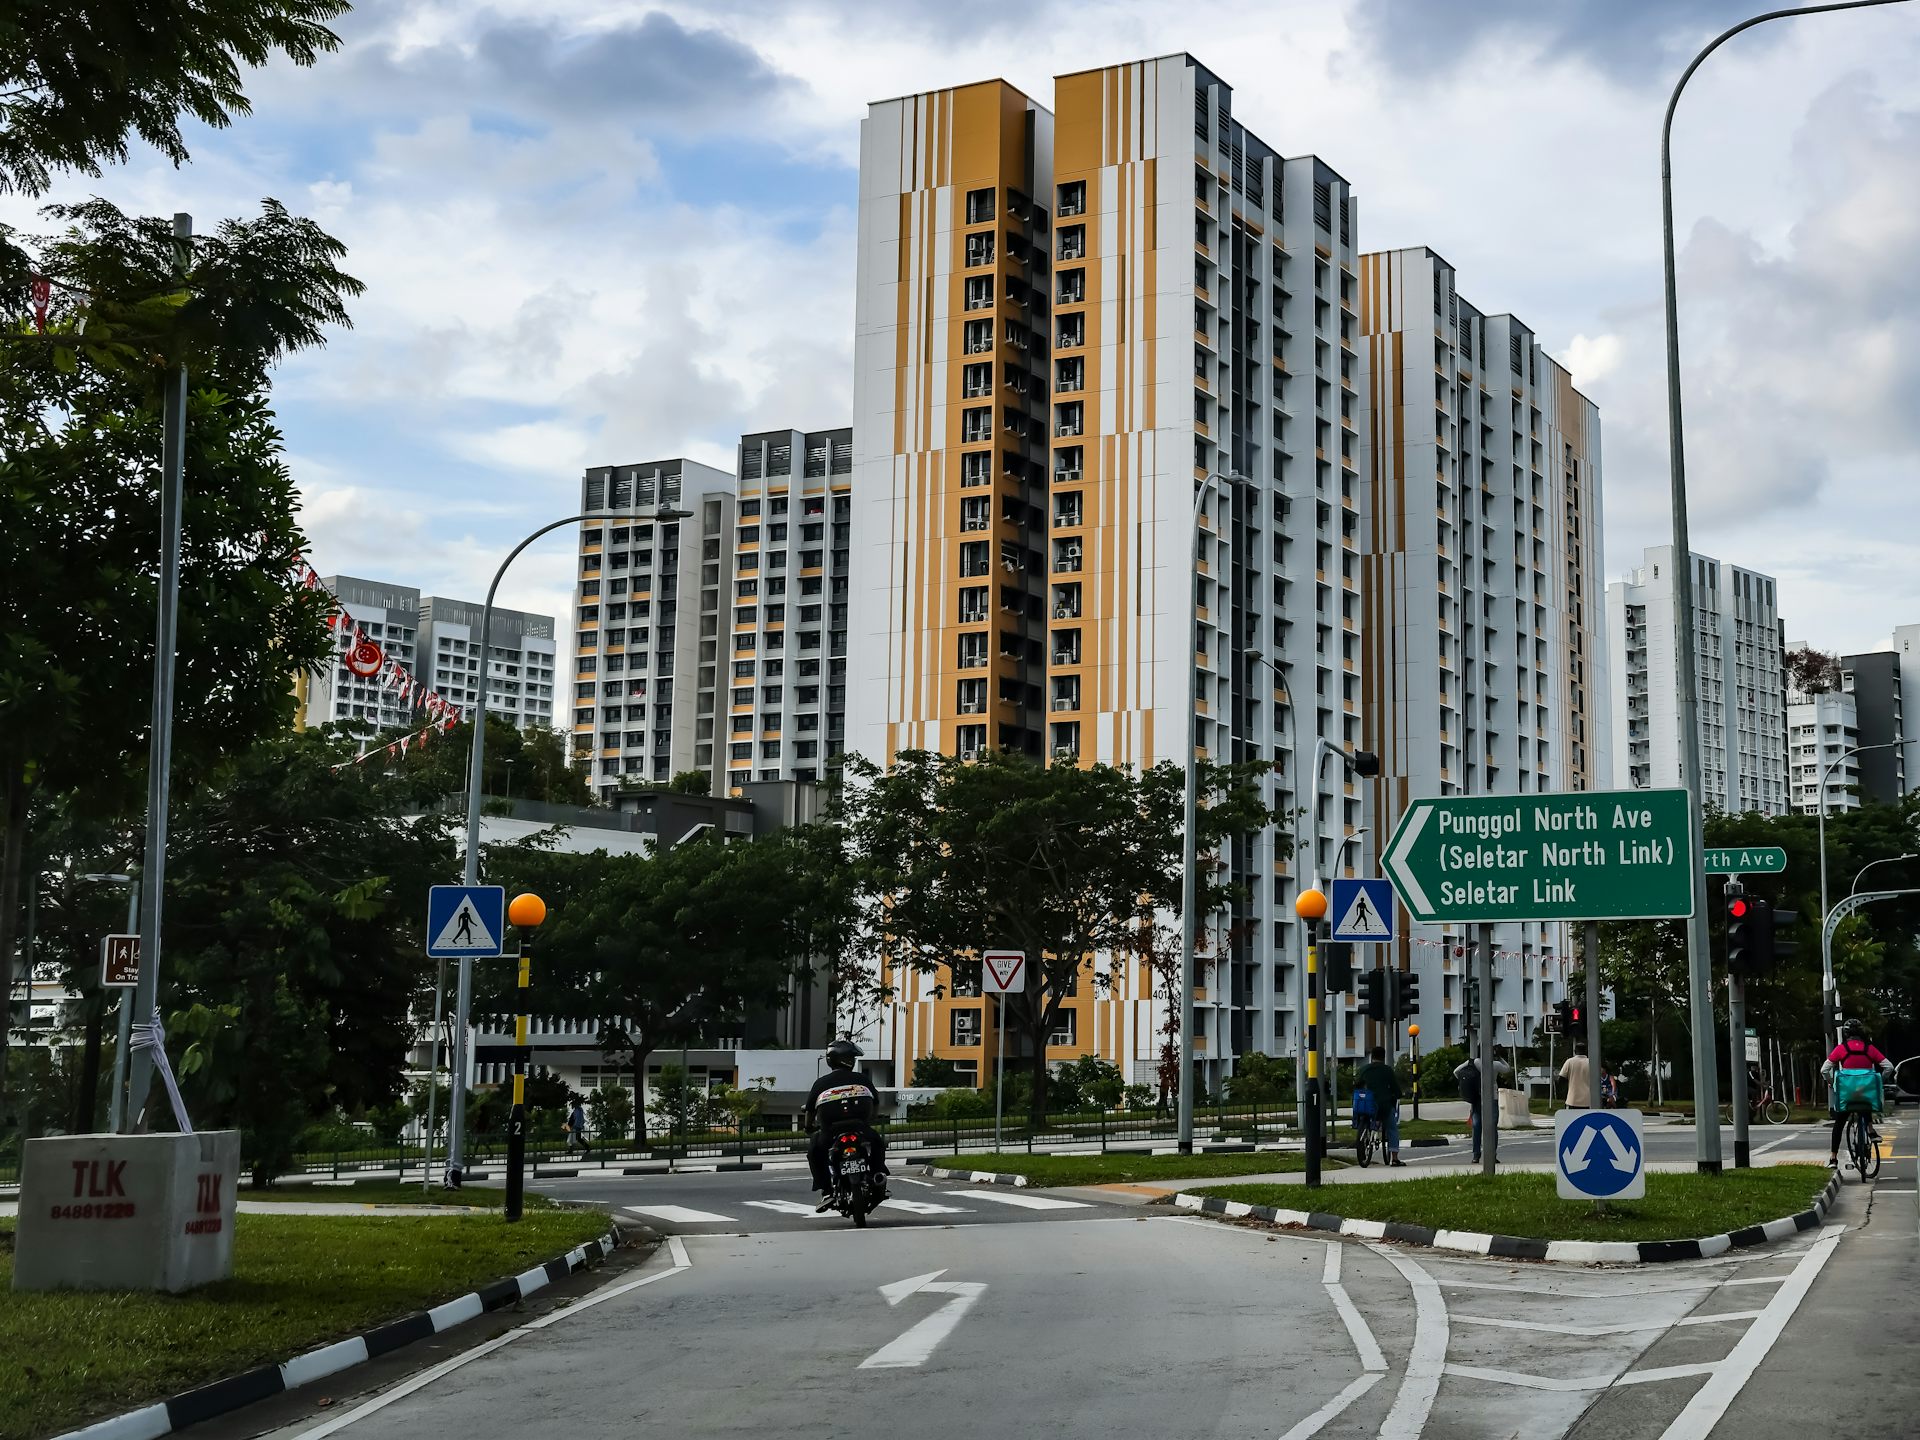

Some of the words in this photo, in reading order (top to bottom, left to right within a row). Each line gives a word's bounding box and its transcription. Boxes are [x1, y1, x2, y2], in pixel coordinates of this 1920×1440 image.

[1439, 808, 1521, 839] Punggol
[1534, 806, 1598, 831] North
[1612, 804, 1652, 829] Ave
[1439, 844, 1528, 871] (Seletar
[1542, 841, 1606, 866] North
[1619, 837, 1674, 865] Link)
[1740, 851, 1774, 866] Ave
[1440, 880, 1519, 905] Seletar
[1533, 878, 1576, 903] Link
[997, 960, 1012, 968] GIVE
[1152, 989, 1171, 1000] 401
[1312, 1093, 1317, 1106] 1
[514, 1121, 522, 1135] 2
[72, 1160, 128, 1198] TLK
[197, 1174, 222, 1213] TLK
